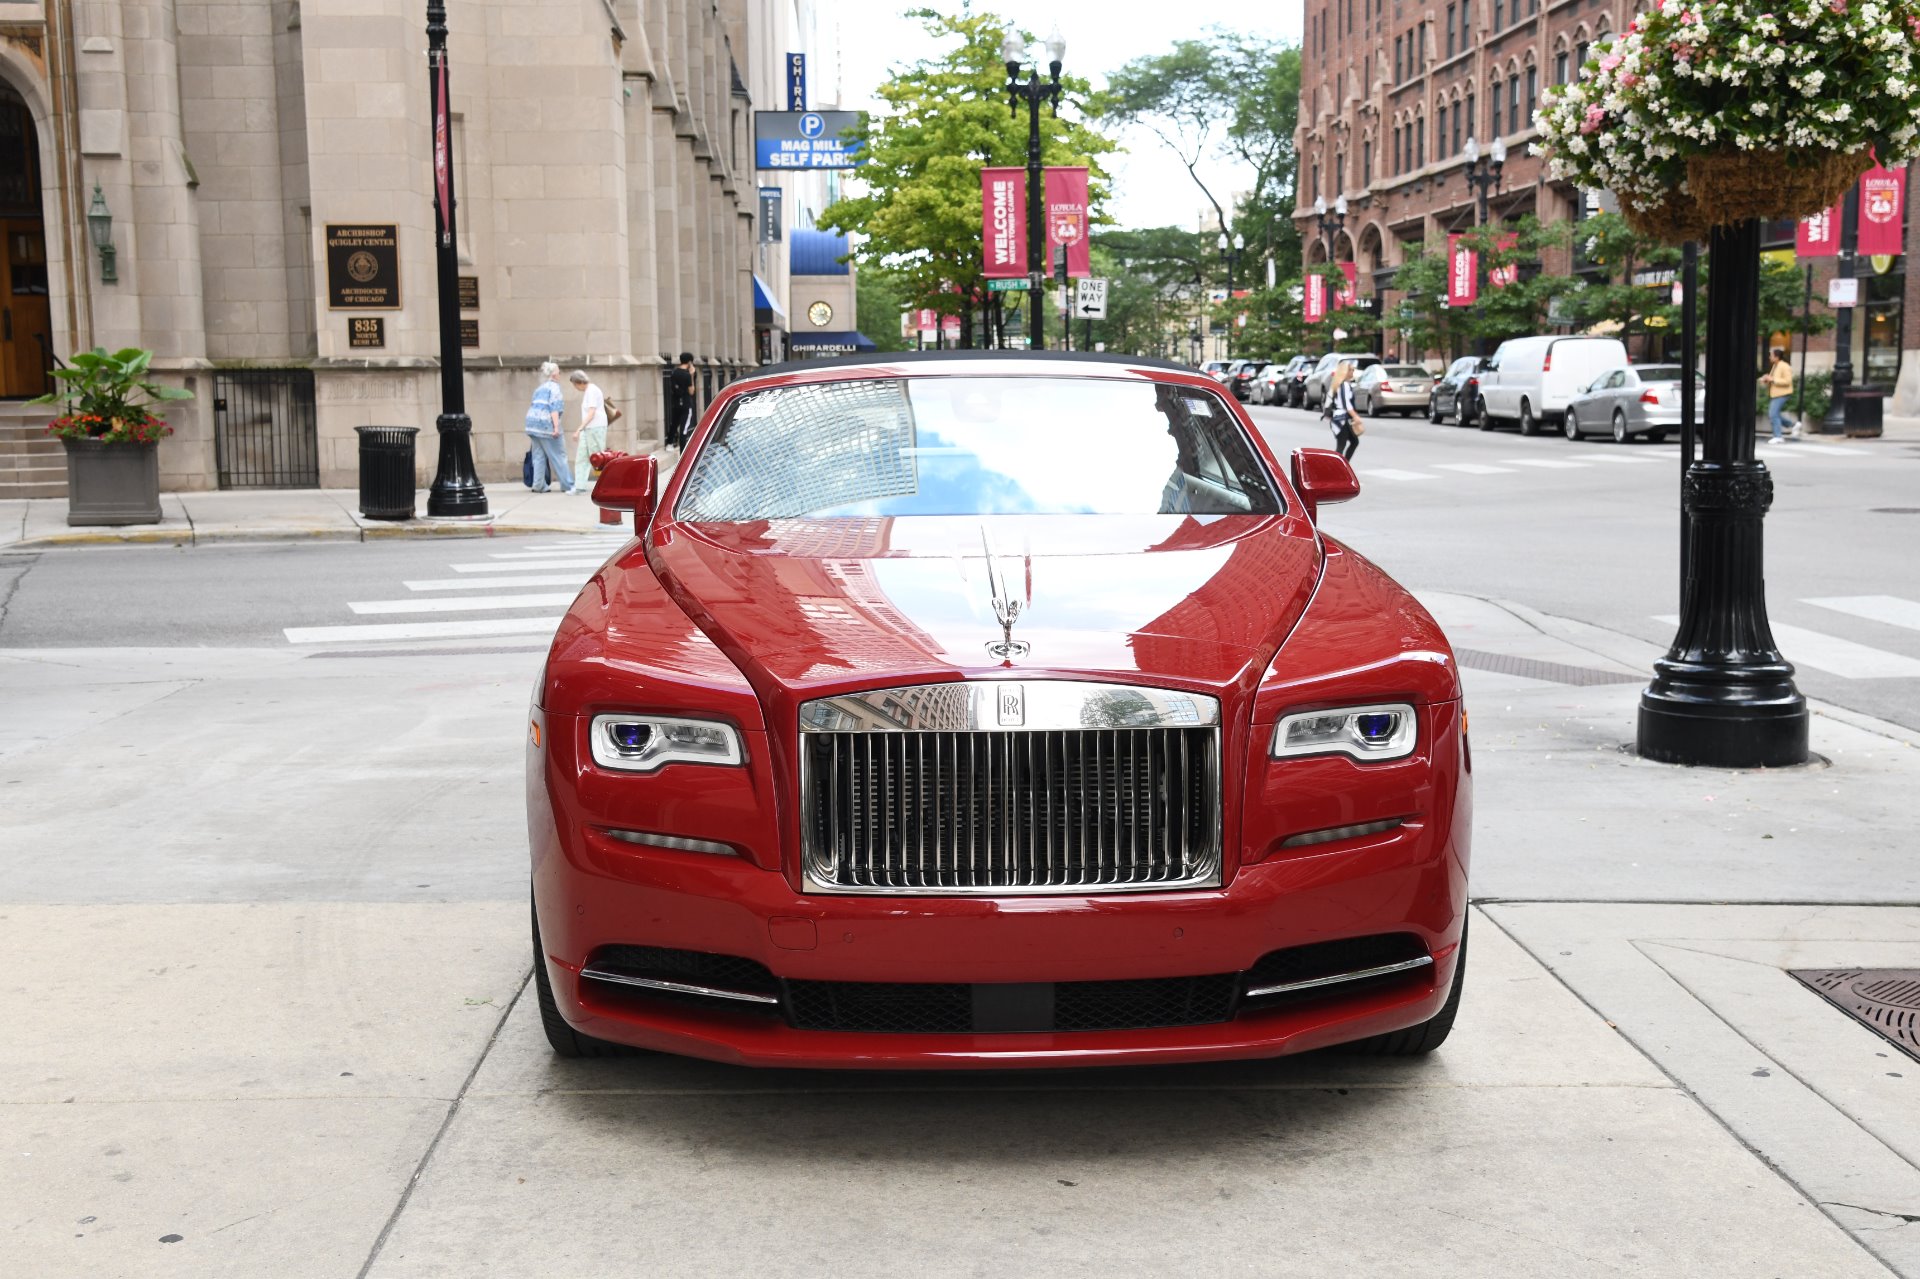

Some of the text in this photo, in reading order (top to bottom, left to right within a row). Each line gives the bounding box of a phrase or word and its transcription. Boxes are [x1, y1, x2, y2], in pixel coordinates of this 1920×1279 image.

[805, 116, 819, 134] P
[781, 140, 810, 151] MAG
[770, 152, 856, 166] SELF PARK
[1007, 181, 1015, 212] CAMPUS
[993, 181, 1008, 265] WELCOME
[1008, 213, 1016, 239] TOWER
[337, 229, 386, 237] ARCHBISHOP
[329, 238, 395, 247] QUIGLEY CENTER
[996, 281, 1017, 290] RUSH
[1081, 282, 1102, 292] ONE
[1081, 293, 1102, 303] WAY
[355, 320, 377, 332] 835
